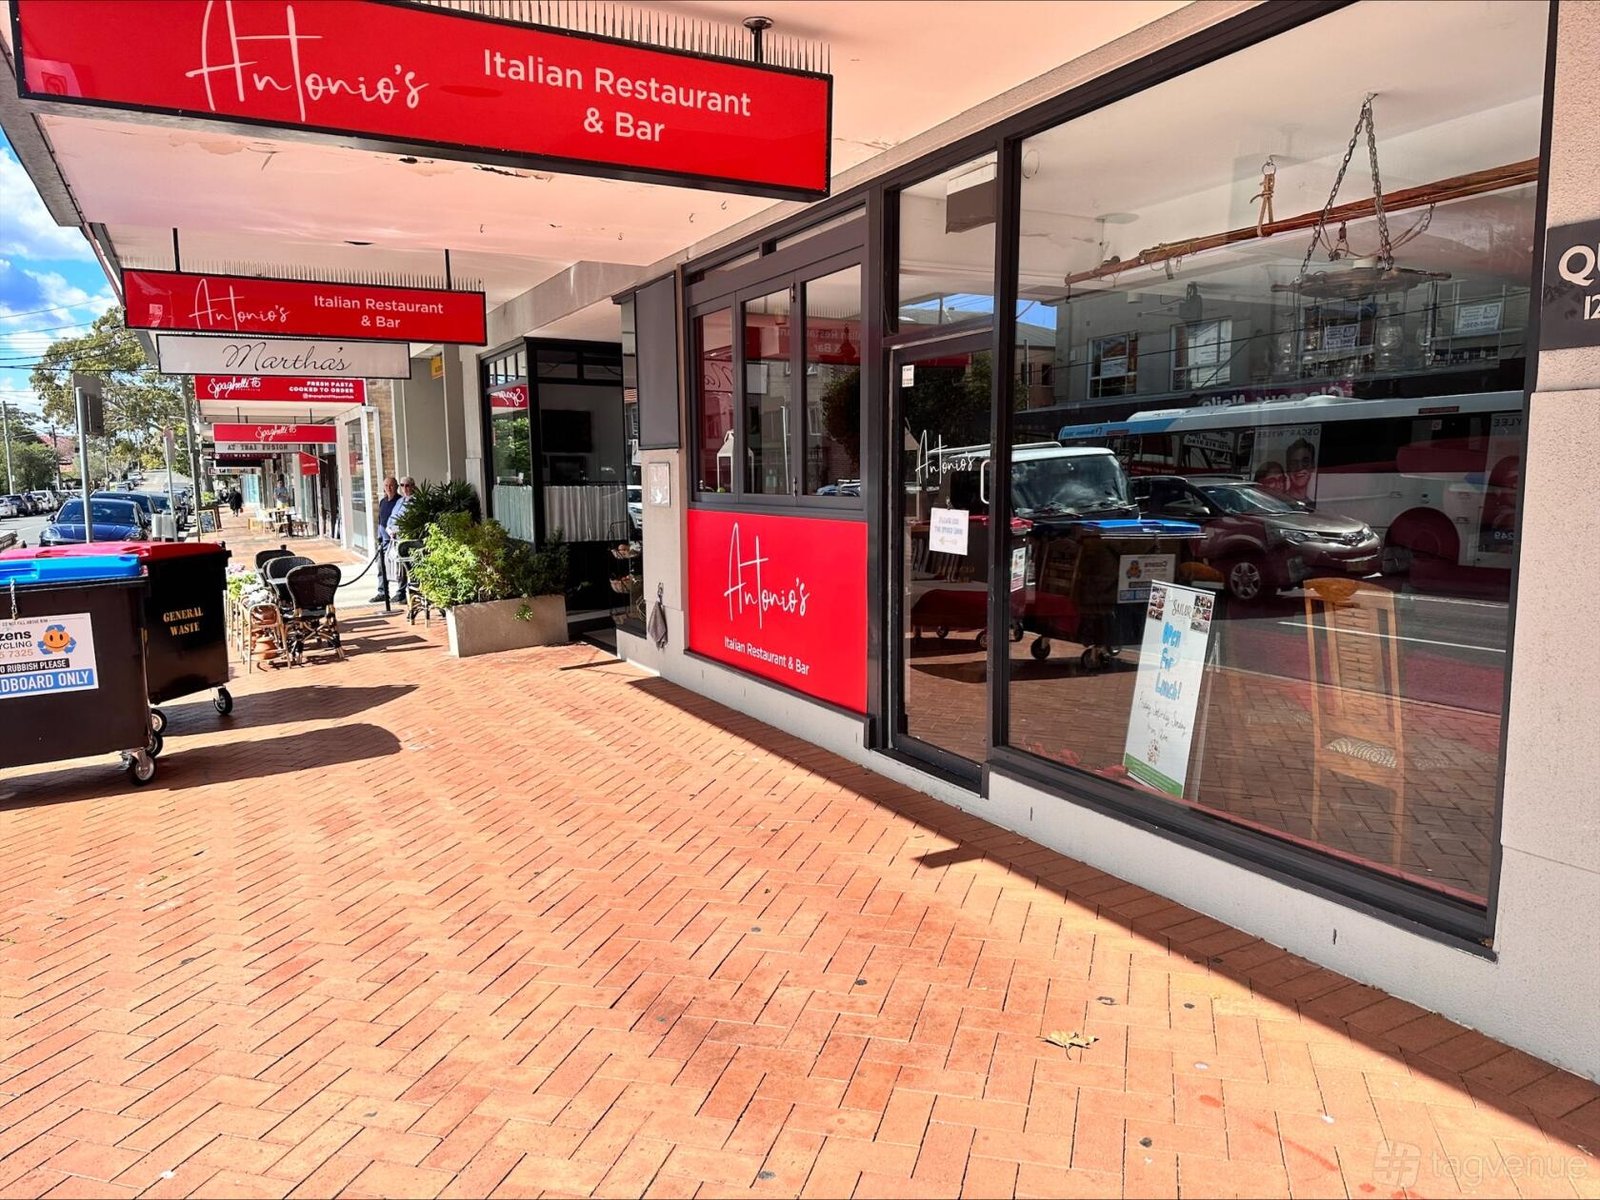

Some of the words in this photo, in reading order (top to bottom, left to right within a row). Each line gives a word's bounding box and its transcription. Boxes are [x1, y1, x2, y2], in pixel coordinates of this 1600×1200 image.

[483, 48, 583, 89] Italian
[593, 67, 752, 118] Restaurant
[582, 106, 606, 135] &
[614, 111, 666, 143] Bar
[1558, 242, 1600, 287] Q
[188, 278, 290, 331] Antonio's
[313, 294, 361, 310] Italian
[364, 297, 444, 315] Restaurant
[360, 315, 372, 328] &
[375, 315, 401, 329] Bar
[223, 341, 351, 372] Martha's
[306, 380, 330, 388] FRESH
[724, 521, 810, 629] Antonio's
[163, 607, 204, 623] GENERAL
[170, 621, 200, 637] WASTE
[7, 661, 39, 673] RUBBISH
[39, 659, 67, 670] PLEASE
[724, 635, 746, 654] Italian
[746, 642, 787, 668] Restaurant
[787, 654, 794, 670] &
[795, 658, 810, 676] Bar
[0, 674, 54, 693] DBOARD
[58, 670, 90, 687] ONLY
